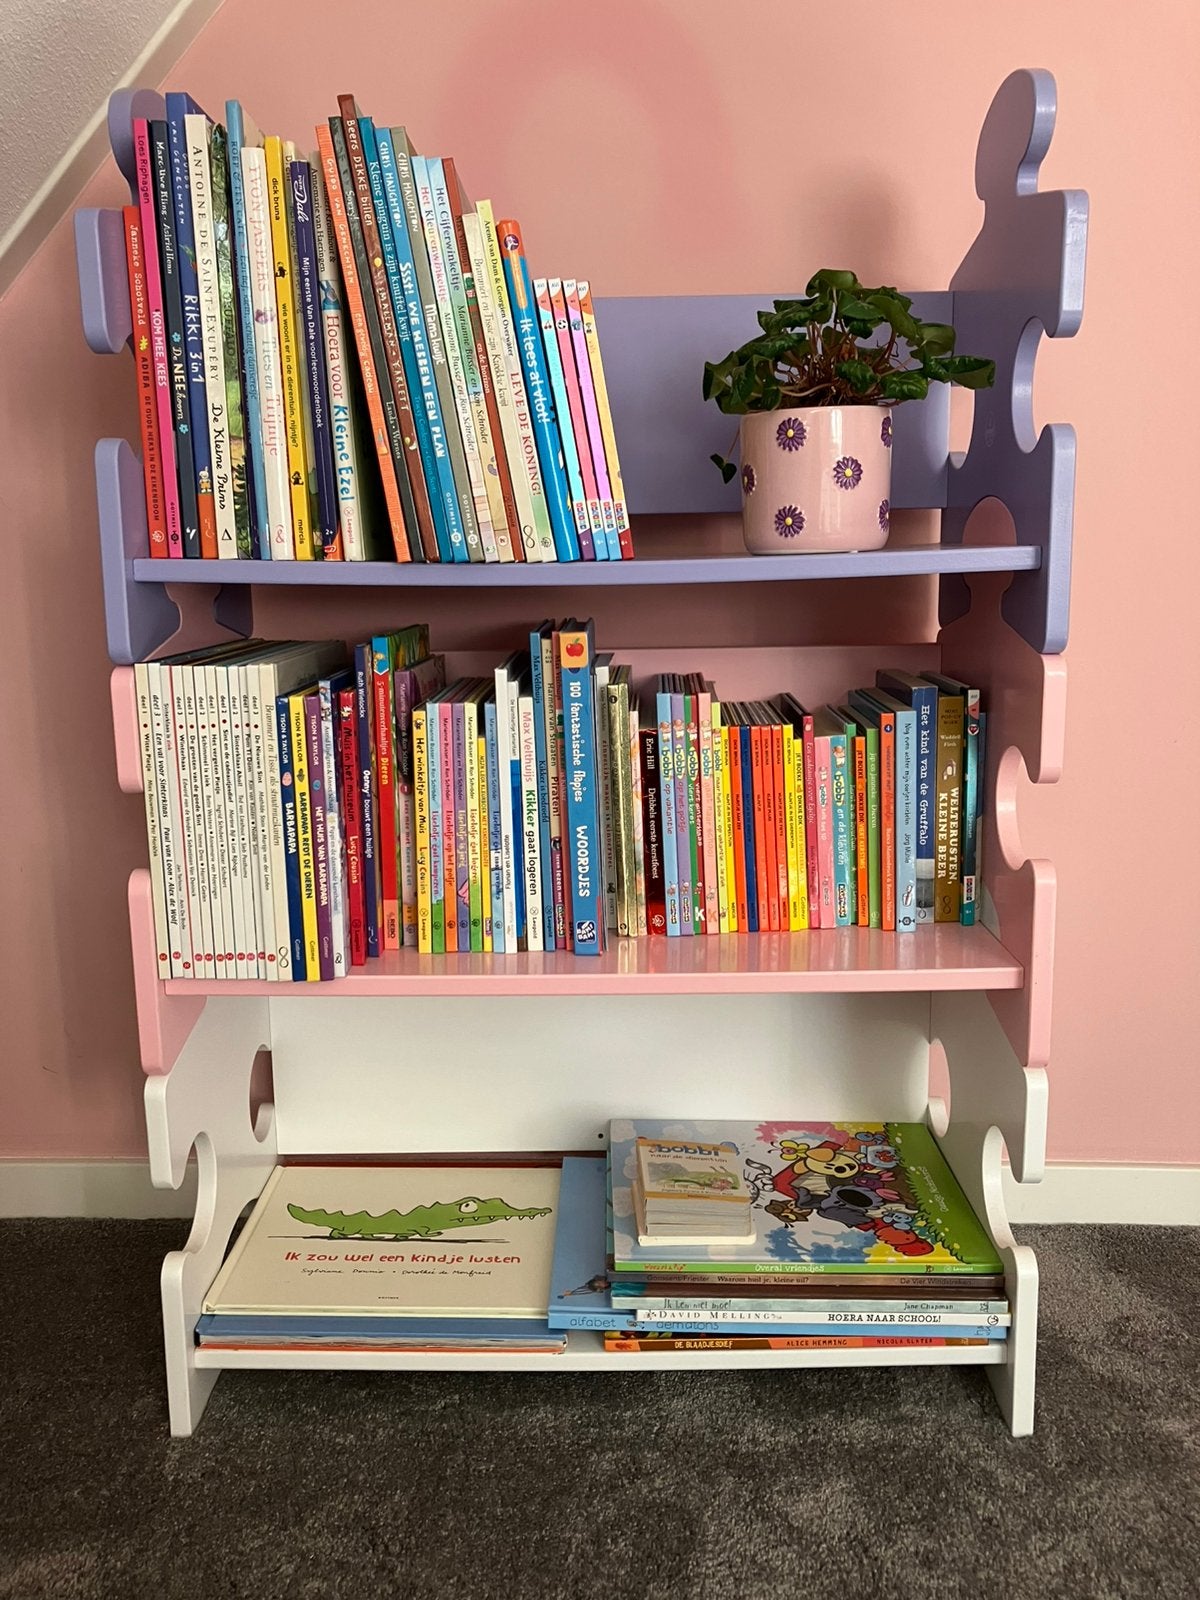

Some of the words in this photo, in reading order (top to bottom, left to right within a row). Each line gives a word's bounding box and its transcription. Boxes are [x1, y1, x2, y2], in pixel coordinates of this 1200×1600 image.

[138, 135, 146, 156] Loes
[346, 119, 359, 149] Beers
[137, 158, 150, 203] Riphagen
[271, 177, 279, 194] dick
[352, 155, 366, 191] DIKKE
[369, 161, 383, 196] Kleine
[310, 167, 321, 213] Annemarie
[435, 187, 446, 206] Het
[273, 196, 281, 220] bruna
[344, 190, 358, 221] Sorry!
[361, 196, 373, 225] billen
[129, 224, 140, 266] Janneke
[483, 219, 493, 242] Arend
[313, 230, 326, 272] Haeringen
[384, 242, 393, 251] is
[437, 210, 461, 291] Cijferwinkeltje
[301, 257, 310, 275] Mijn
[384, 253, 397, 272] zijn
[490, 259, 499, 276] Dam
[304, 277, 312, 302] eerste
[399, 261, 415, 295] Ssst!
[134, 272, 145, 325] Schotveld
[390, 275, 405, 313] knuffel
[494, 285, 507, 318] Georgien
[152, 311, 162, 334] KOM
[306, 304, 314, 320] Van
[407, 301, 420, 325] WE
[519, 318, 532, 332] Ik
[307, 322, 315, 339] Dale
[326, 314, 341, 360] Hoera
[396, 316, 410, 341] kwijt
[501, 319, 513, 356] Overwater
[152, 336, 164, 360] MEE,
[412, 329, 431, 386] HEBBEN
[523, 335, 538, 367] lees
[140, 356, 149, 388] ADIBA
[156, 362, 166, 386] KEES
[285, 364, 292, 374] de
[330, 363, 342, 399] voor
[529, 370, 542, 386] al
[285, 376, 296, 418] dierentuin,
[510, 372, 524, 407] LEVE
[211, 403, 223, 422] De
[424, 391, 437, 420] EEN
[532, 388, 549, 423] vlot!
[288, 419, 298, 447] nijntje?
[333, 403, 352, 461] Kleine
[517, 412, 528, 430] DE
[212, 428, 227, 469] Kleine
[431, 426, 445, 457] PLAN
[521, 435, 541, 496] KONING!
[216, 474, 230, 509] Prins
[338, 466, 355, 500] Ezel
[569, 681, 580, 697] 100
[522, 711, 531, 733] Max
[921, 705, 929, 725] Het
[416, 737, 424, 753] Het
[570, 702, 585, 765] fantastische
[920, 730, 929, 754] kind
[522, 737, 533, 782] Velthuijs
[415, 757, 424, 795] winkeltje
[569, 770, 586, 801] flapjes
[834, 774, 844, 802] bobbi
[920, 783, 928, 795] de
[159, 778, 168, 817] Sinterklaas
[525, 789, 536, 826] Kikker
[648, 788, 656, 818] Dribbels
[285, 802, 295, 853] BARBAPAPA
[418, 815, 426, 833] Muis
[836, 809, 842, 819] en
[838, 821, 844, 831] de
[919, 800, 928, 845] Gruffalo
[938, 792, 947, 840] KLEINE
[299, 791, 307, 834] BARBAPAPA
[304, 859, 309, 868] DE
[525, 830, 535, 853] gaat
[947, 786, 958, 884] WELTERUSTEN,
[346, 836, 358, 854] Lucy
[417, 846, 427, 864] Lucy
[837, 834, 846, 864] kleuren
[350, 856, 358, 883] Cousins
[576, 825, 589, 896] WOORDJES
[650, 843, 658, 878] kerstfeest
[937, 845, 946, 878] BEER
[318, 863, 327, 905] BARBAPAPA
[419, 867, 427, 894] Cousins
[526, 857, 538, 895] logeren
[169, 898, 175, 906] de
[169, 908, 177, 925] Wolf
[658, 1144, 719, 1156] bobbi
[285, 1252, 302, 1261] Ik
[345, 1253, 373, 1262] wel
[380, 1254, 404, 1262] een
[411, 1253, 463, 1264] kindje
[469, 1254, 521, 1263] lusten
[785, 1264, 824, 1273] vriendjes
[570, 1313, 616, 1328] alfabet
[828, 1314, 863, 1322] HOERA
[866, 1314, 895, 1322] NAAR
[898, 1314, 941, 1323] SCHOOL!
[904, 1302, 920, 1310] Jane
[922, 1303, 953, 1311] Chapman
